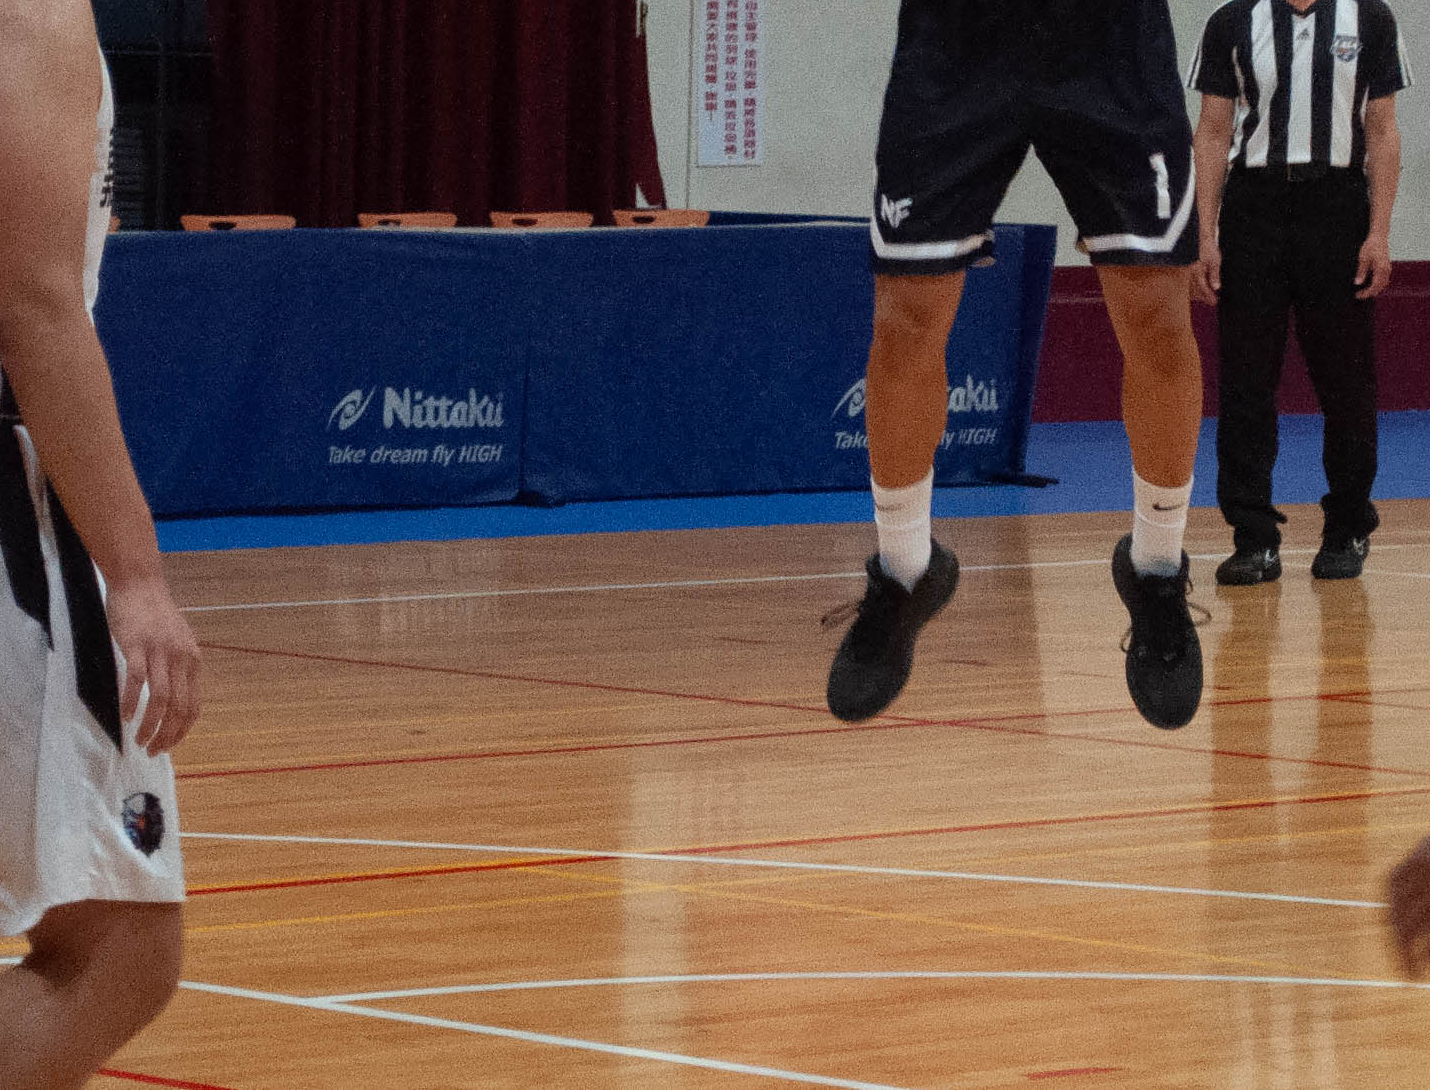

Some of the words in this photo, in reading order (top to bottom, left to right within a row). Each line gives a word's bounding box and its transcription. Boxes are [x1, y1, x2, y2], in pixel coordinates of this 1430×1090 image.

[1148, 152, 1172, 220] 1
[382, 386, 505, 430] Nittaku
[328, 444, 367, 464] Take
[370, 445, 428, 464] dream
[432, 443, 455, 468] fly
[459, 444, 503, 463] HIGH
[939, 429, 955, 450] ly
[958, 427, 999, 446] HIGH
